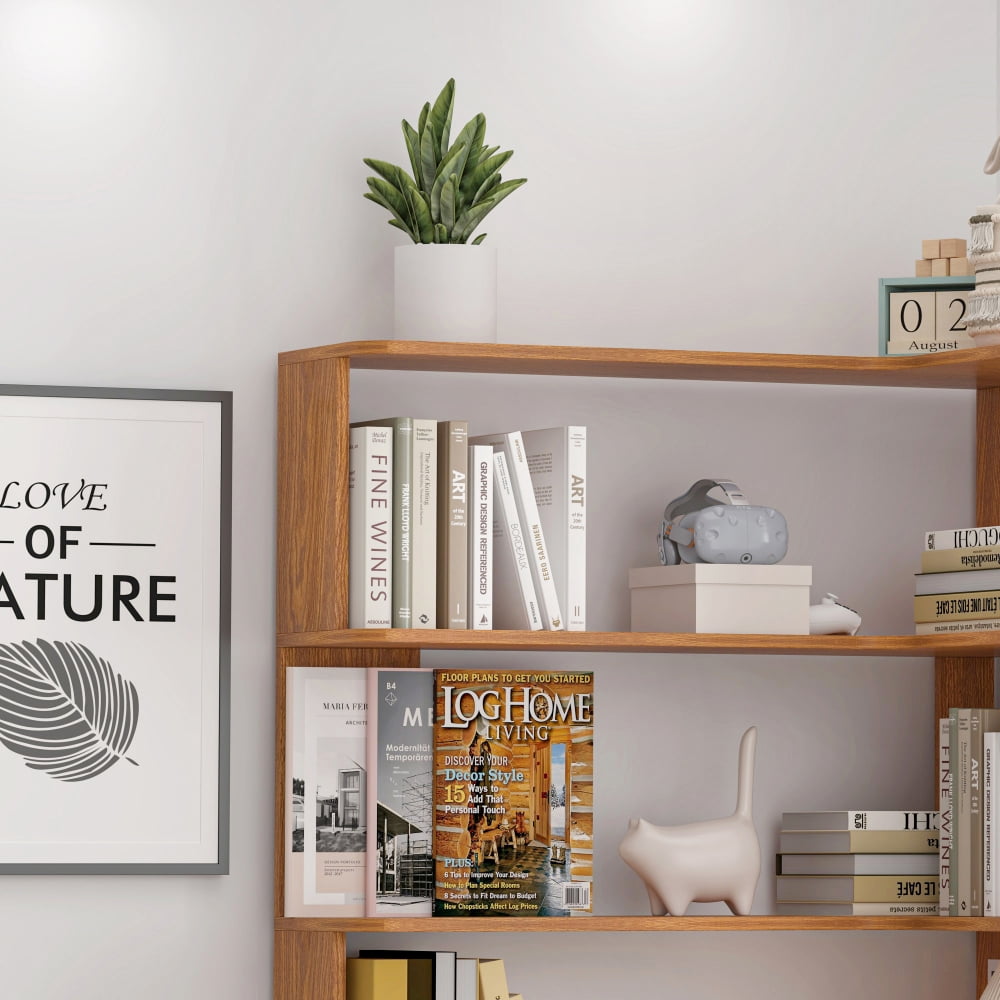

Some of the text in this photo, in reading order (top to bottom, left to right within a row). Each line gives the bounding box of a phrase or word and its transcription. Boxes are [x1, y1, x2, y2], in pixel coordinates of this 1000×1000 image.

[908, 340, 958, 352] August
[0, 478, 107, 512] LOVE
[370, 455, 388, 509] FINE
[452, 470, 466, 504] ART
[571, 474, 584, 507] ART
[25, 524, 82, 560] OF
[479, 461, 488, 595] GRAPHIC DESIGN REFERENCED
[370, 520, 388, 602] WINES
[401, 533, 410, 561] WRIGHT
[511, 523, 528, 570] BORDEAUX
[532, 524, 550, 581] EERO SAARINEN
[441, 673, 591, 683] FLOOR PLANS TO GET YOU STARTED
[385, 743, 430, 752] Modernität
[485, 725, 549, 741] LIVING
[445, 755, 508, 766] DISCOVER YOUR
[971, 758, 979, 790] ART
[444, 768, 524, 784] Decor Style
[444, 784, 499, 803] 15 Ways to
[467, 795, 503, 804] Add That
[445, 806, 506, 814] Personal Touch
[941, 746, 950, 889] FINE WINES
[896, 882, 936, 899] LE CAFÉ
